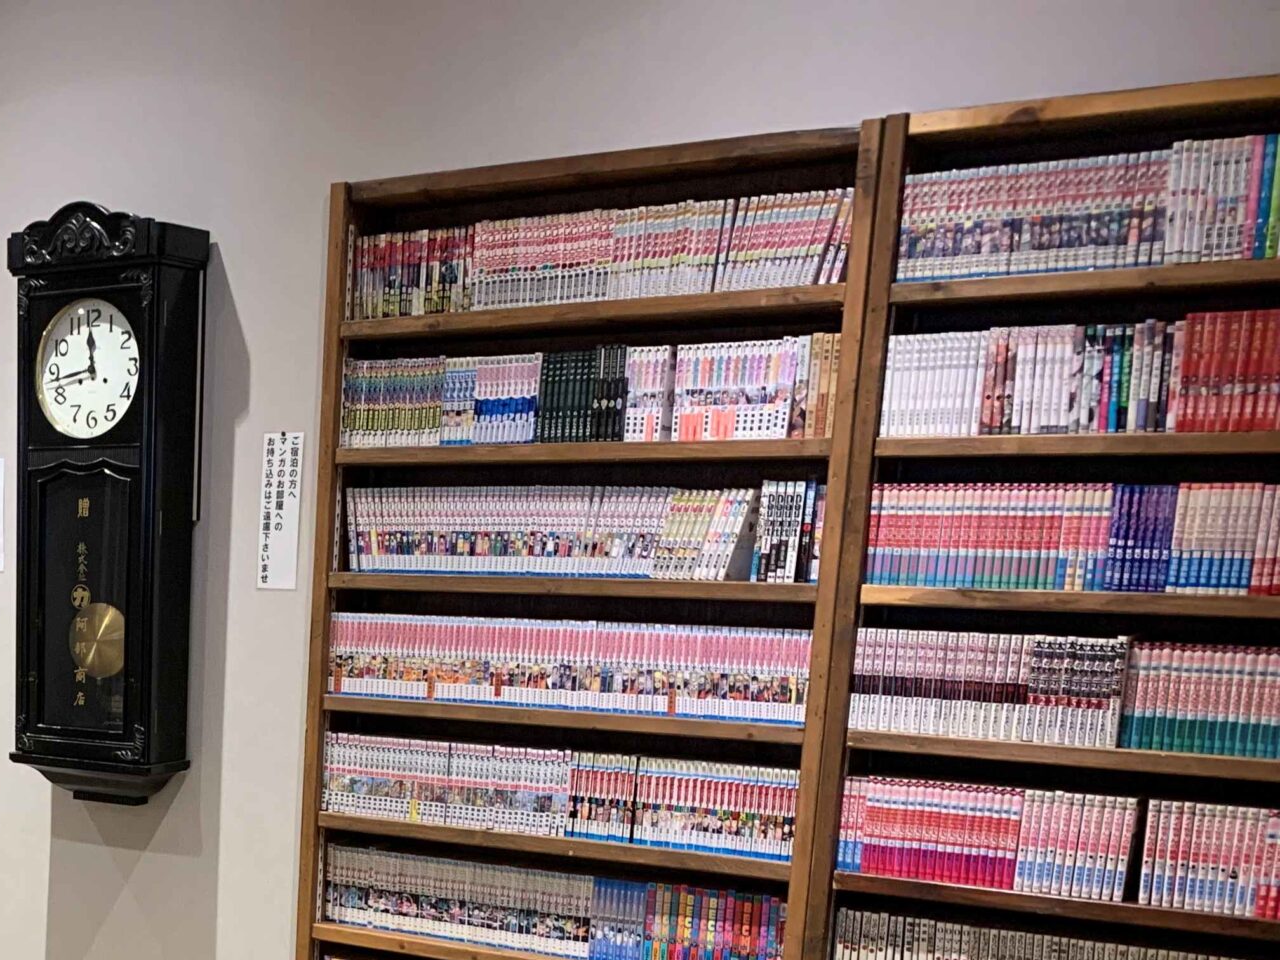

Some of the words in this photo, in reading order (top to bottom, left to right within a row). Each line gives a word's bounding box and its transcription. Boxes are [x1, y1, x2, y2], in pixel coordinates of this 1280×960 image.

[70, 316, 81, 336] 11
[86, 308, 102, 328] 12
[109, 313, 113, 333] 1
[55, 338, 69, 357] 10
[120, 330, 132, 349] 2
[48, 363, 61, 382] 9
[127, 357, 139, 376] 3
[54, 386, 67, 405] 8
[120, 382, 131, 401] 4
[70, 404, 82, 423] 7
[86, 409, 98, 429] 6
[104, 403, 117, 422] 5
[288, 436, 301, 498] ご宿泊の方へ
[275, 437, 287, 531] マンガのお部屋への
[77, 497, 90, 518] 贈
[261, 437, 275, 584] お持ち込みはご遠慮下さいませ
[684, 895, 694, 939] BECK
[706, 898, 717, 942] BECK
